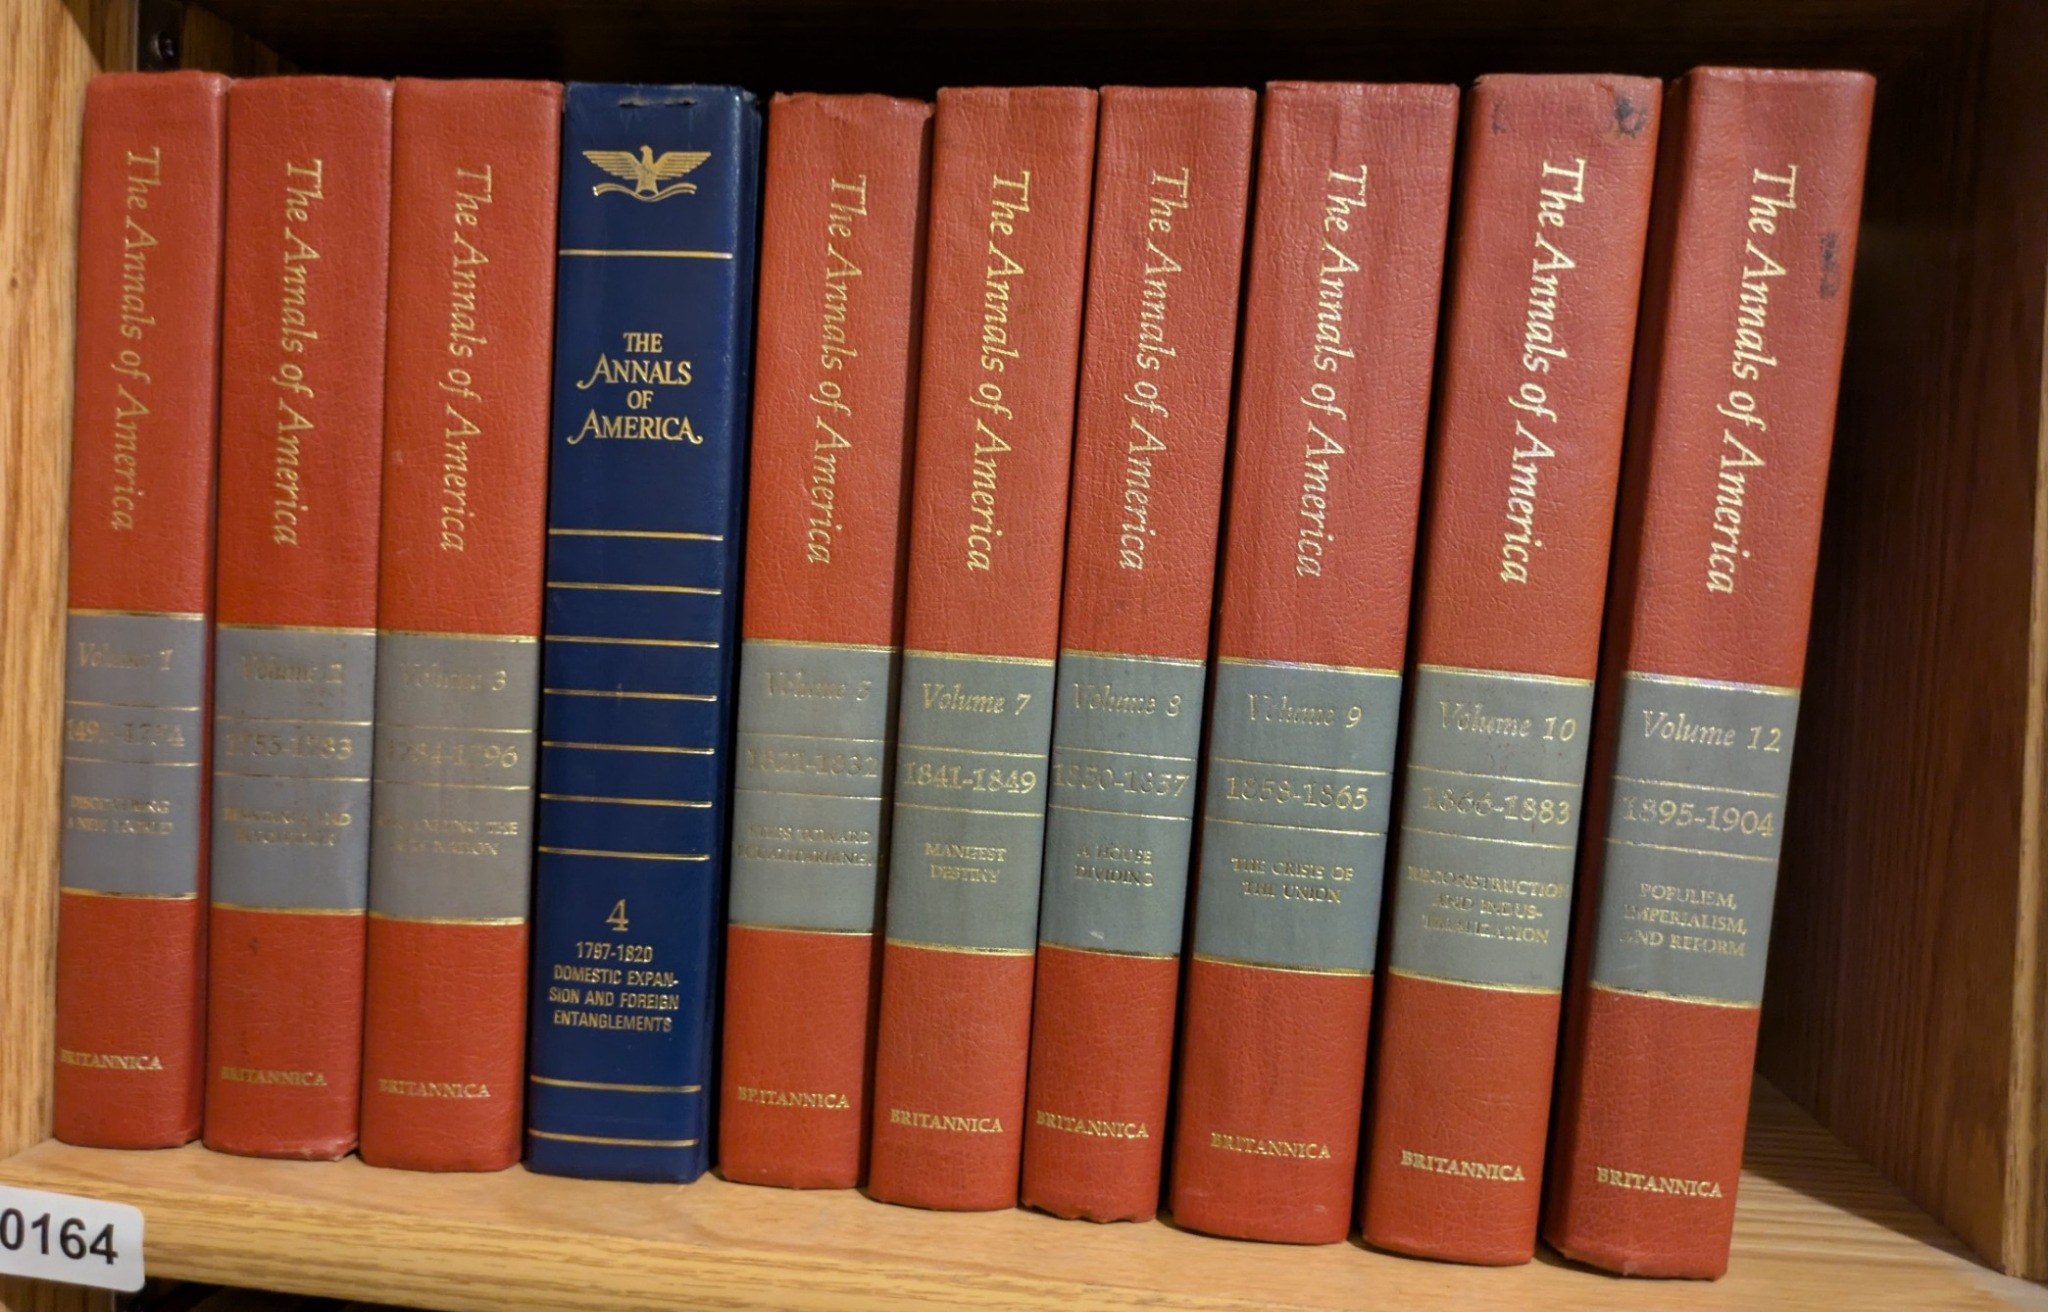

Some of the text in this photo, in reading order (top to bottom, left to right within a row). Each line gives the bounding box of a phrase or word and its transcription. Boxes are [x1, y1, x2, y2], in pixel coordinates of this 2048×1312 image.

[111, 147, 161, 531] The Annals of America
[271, 159, 324, 546] The Annals of America
[622, 332, 663, 353] THE
[438, 164, 493, 552] The Annals of America
[576, 353, 692, 390] ANNALS
[807, 174, 868, 565] The Annals of America
[965, 170, 1031, 571] The Annals of America
[1118, 167, 1190, 571] The Annals of America
[1295, 164, 1369, 578] The Annals of America
[1500, 158, 1586, 585] The Annals of America
[1705, 164, 1798, 596] The Annals of America
[626, 390, 654, 410] OF
[566, 408, 704, 445] AMERICA
[492, 670, 507, 691] 3
[922, 682, 1032, 716] Volume 7
[1073, 682, 1182, 717] Volume 8
[1248, 693, 1362, 728] Volume 9
[1439, 700, 1577, 741] Volume 10
[1642, 710, 1782, 753] Volume 12
[904, 761, 1037, 794] 1841-1849
[1053, 763, 1190, 797] 1850-1857
[1226, 776, 1369, 810] 1858-1865
[1423, 787, 1571, 825] 1866-1883
[1623, 796, 1775, 837] 1895-1904
[924, 842, 1007, 862] MANIFEST
[1097, 845, 1152, 865] HOUSE
[930, 863, 1001, 884] DESTINY
[1074, 864, 1154, 887] DIVIDING
[1231, 857, 1354, 881] THE CRISIS OF
[1407, 865, 1570, 899] RECONSTRUCTION
[1241, 881, 1341, 904] THE UNION
[1432, 895, 1543, 919] AND INDUS-
[1640, 882, 1737, 910] POPULISM,
[605, 898, 630, 932] 4
[1623, 903, 1747, 936] IMPERIALISM,
[576, 941, 654, 963] 1797-1820
[1669, 933, 1746, 957] REFORM
[553, 964, 679, 988] DOMESTIC EXPAN-
[549, 986, 680, 1011] SION AND FOREIGN
[553, 1010, 673, 1033] ENTANGLEMENTS
[60, 1049, 163, 1071] BRITANNICA
[220, 1065, 327, 1087] BRITANNICA
[378, 1078, 491, 1098] BRITANNICA
[738, 1086, 850, 1110] BRITANNICA
[890, 1108, 1003, 1134] BRITANNICA
[1036, 1109, 1150, 1139] BRITANNICA
[1211, 1132, 1331, 1160] BRITANNICA
[1400, 1150, 1526, 1182] BRITANNICA
[1596, 1167, 1723, 1199] BRITANNICA
[0, 1208, 119, 1265] 0164
